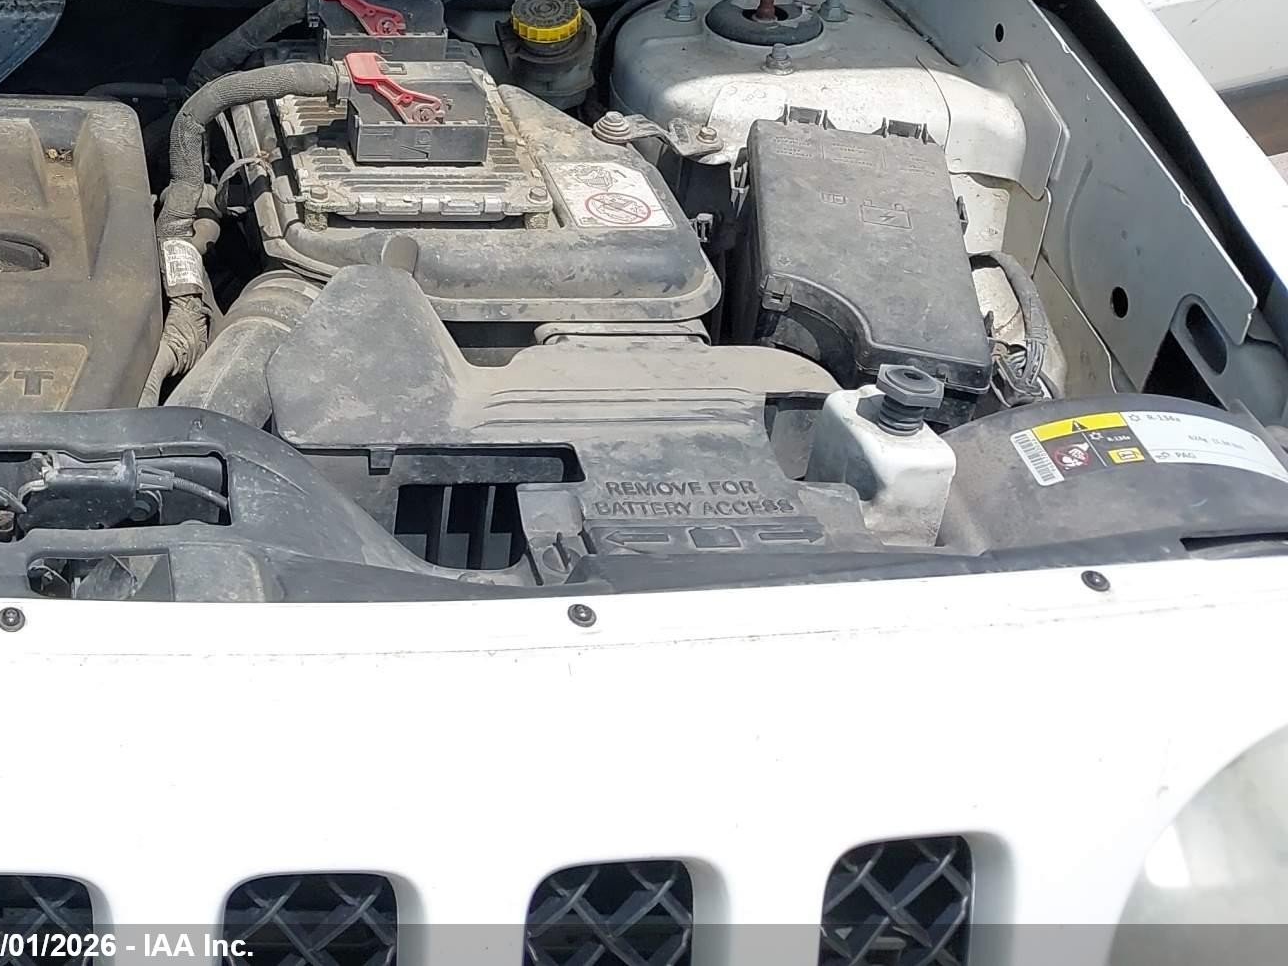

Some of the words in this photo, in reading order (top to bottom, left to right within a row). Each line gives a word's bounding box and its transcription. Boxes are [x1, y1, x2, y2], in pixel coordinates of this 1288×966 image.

[605, 481, 705, 496] REMOVE
[710, 480, 758, 495] FOR
[594, 501, 692, 516] BATTERY
[703, 498, 795, 516] ACCESS
